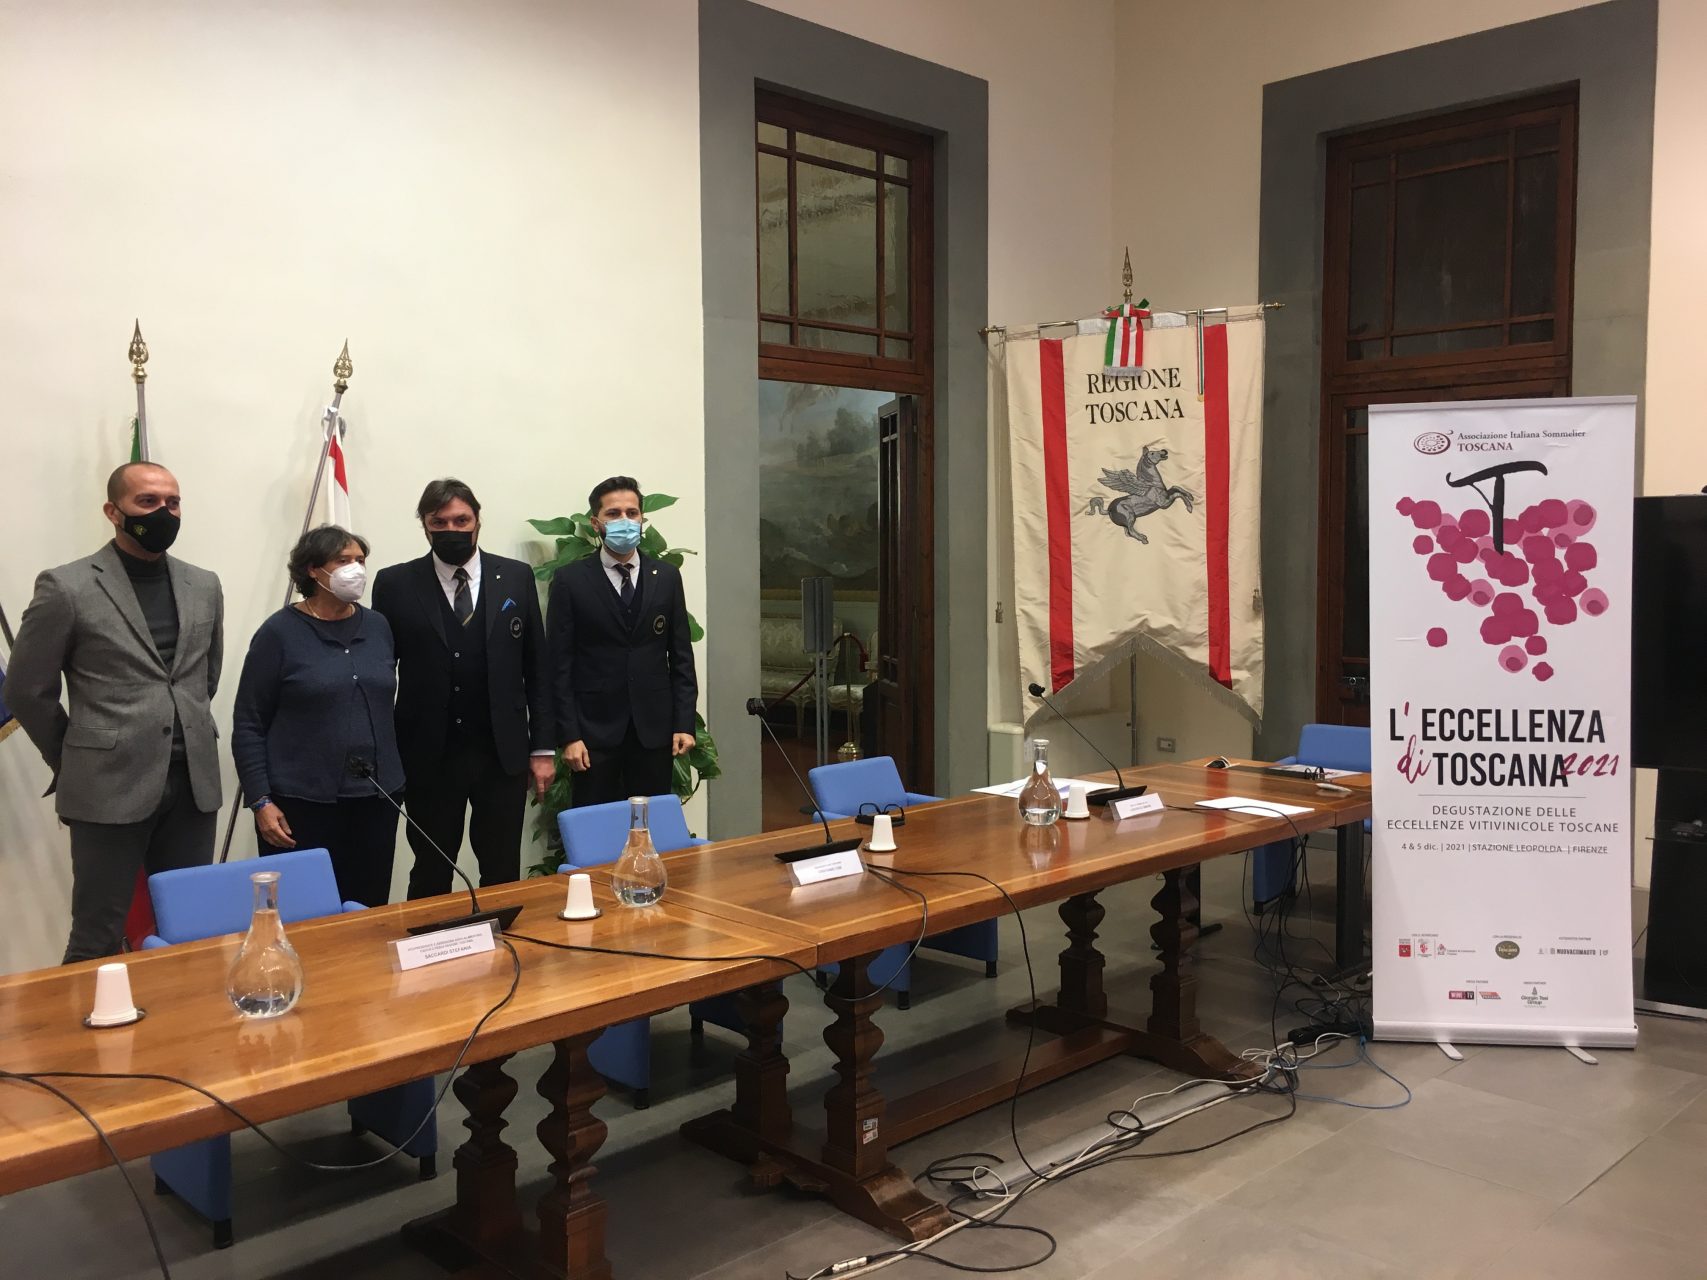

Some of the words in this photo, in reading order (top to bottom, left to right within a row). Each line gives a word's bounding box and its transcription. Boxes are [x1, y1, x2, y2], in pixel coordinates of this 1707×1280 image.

[1087, 368, 1181, 394] REGIONE
[1086, 399, 1185, 424] TOSCANA
[1457, 432, 1508, 440] Associazione
[1510, 431, 1540, 439] Italiana
[1542, 430, 1586, 438] Sommelier
[1457, 442, 1514, 452] TOSCANA
[1396, 734, 1432, 784] di
[1432, 752, 1568, 787] TOSCANA
[1560, 752, 1620, 777] 2021
[1432, 805, 1532, 817] DEGUSTAZIONE
[1536, 807, 1577, 818] DELLE
[1387, 819, 1465, 831] ECCELLENZE
[1469, 821, 1555, 832] VITIVINICOLE
[1558, 822, 1619, 833] TOSCANE
[1445, 843, 1466, 851] 2021
[1472, 843, 1514, 852] STAZIONE
[1516, 844, 1562, 853] LEOPOLDA
[1572, 845, 1608, 854] FIRENZE
